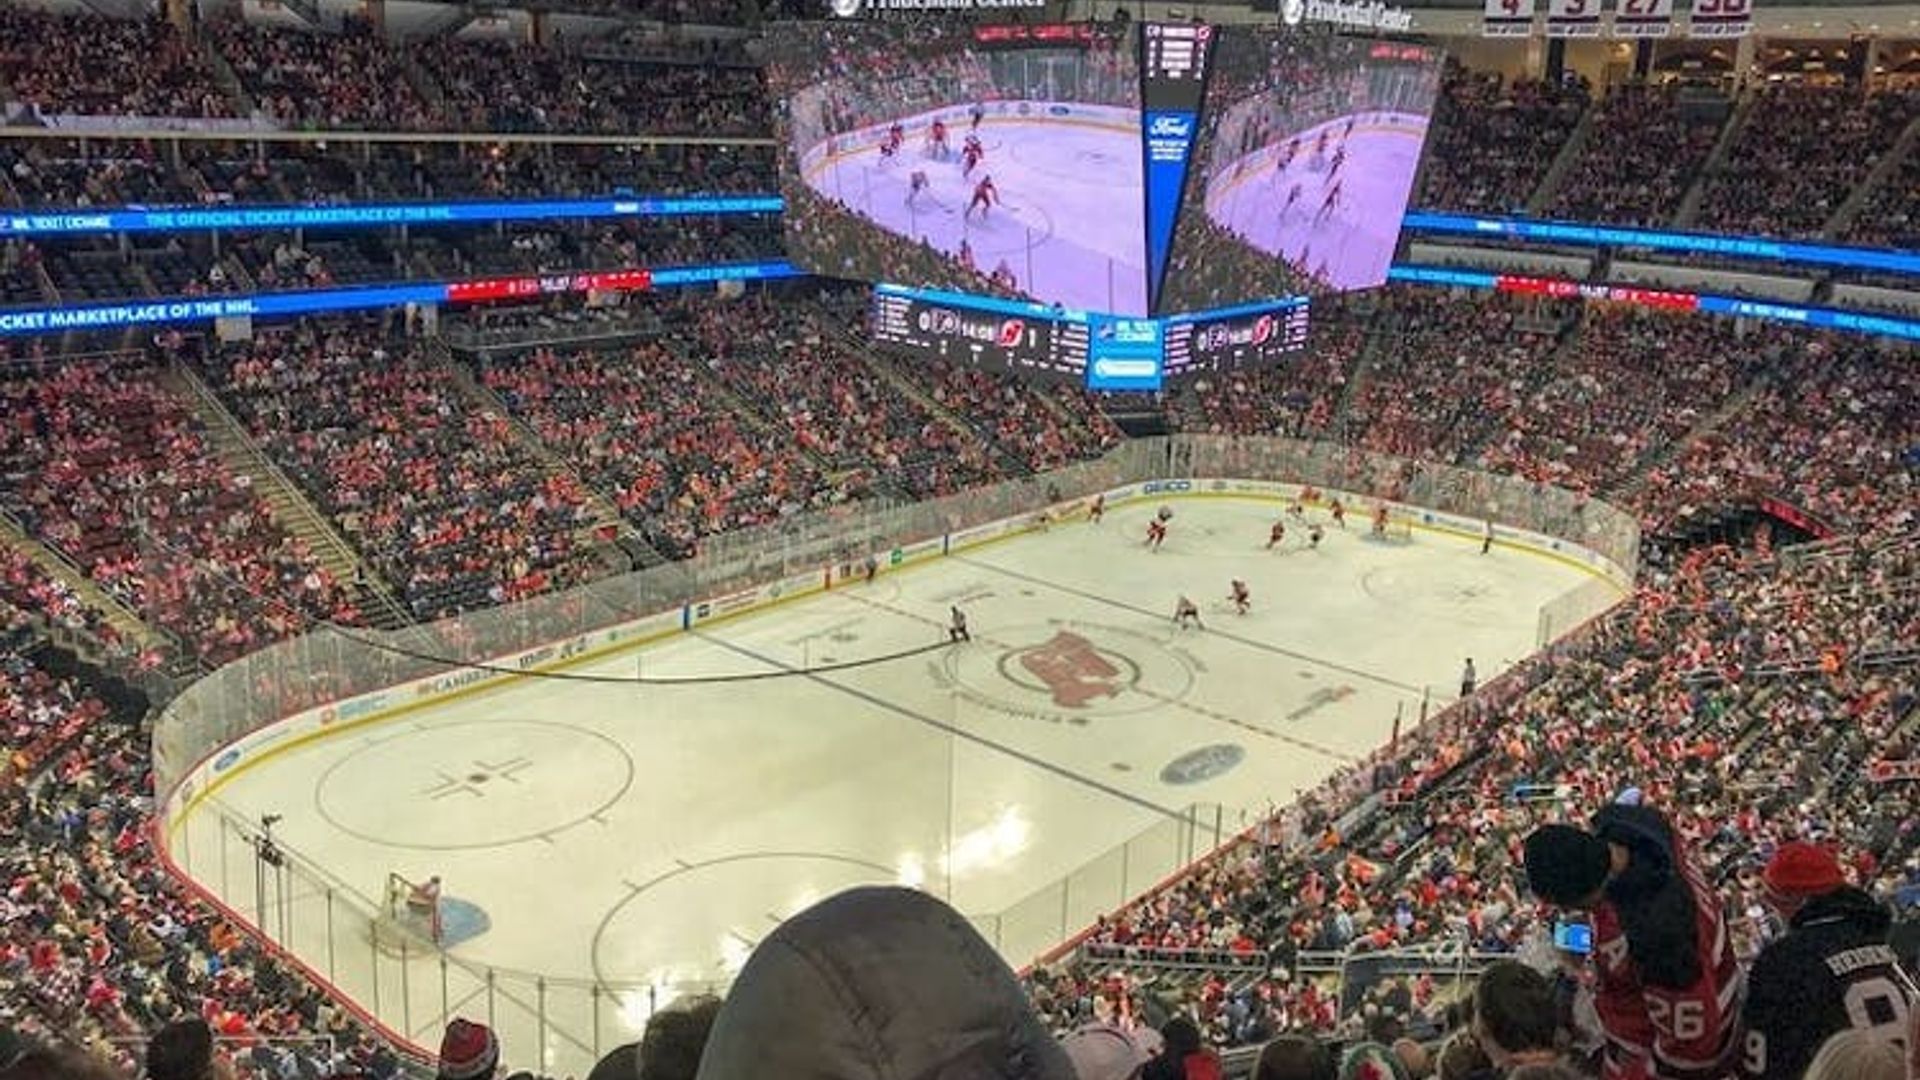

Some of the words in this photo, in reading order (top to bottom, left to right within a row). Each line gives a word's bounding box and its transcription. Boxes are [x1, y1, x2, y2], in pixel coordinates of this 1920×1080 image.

[177, 211, 241, 227] OFFICIAL
[293, 207, 384, 224] MARKETPLACE
[0, 312, 45, 330] CKET
[50, 304, 165, 327] MARKETPLACE
[169, 303, 191, 319] OF
[195, 301, 222, 315] THE
[1641, 992, 1704, 1039] 26
[1742, 1029, 1766, 1074] 9
